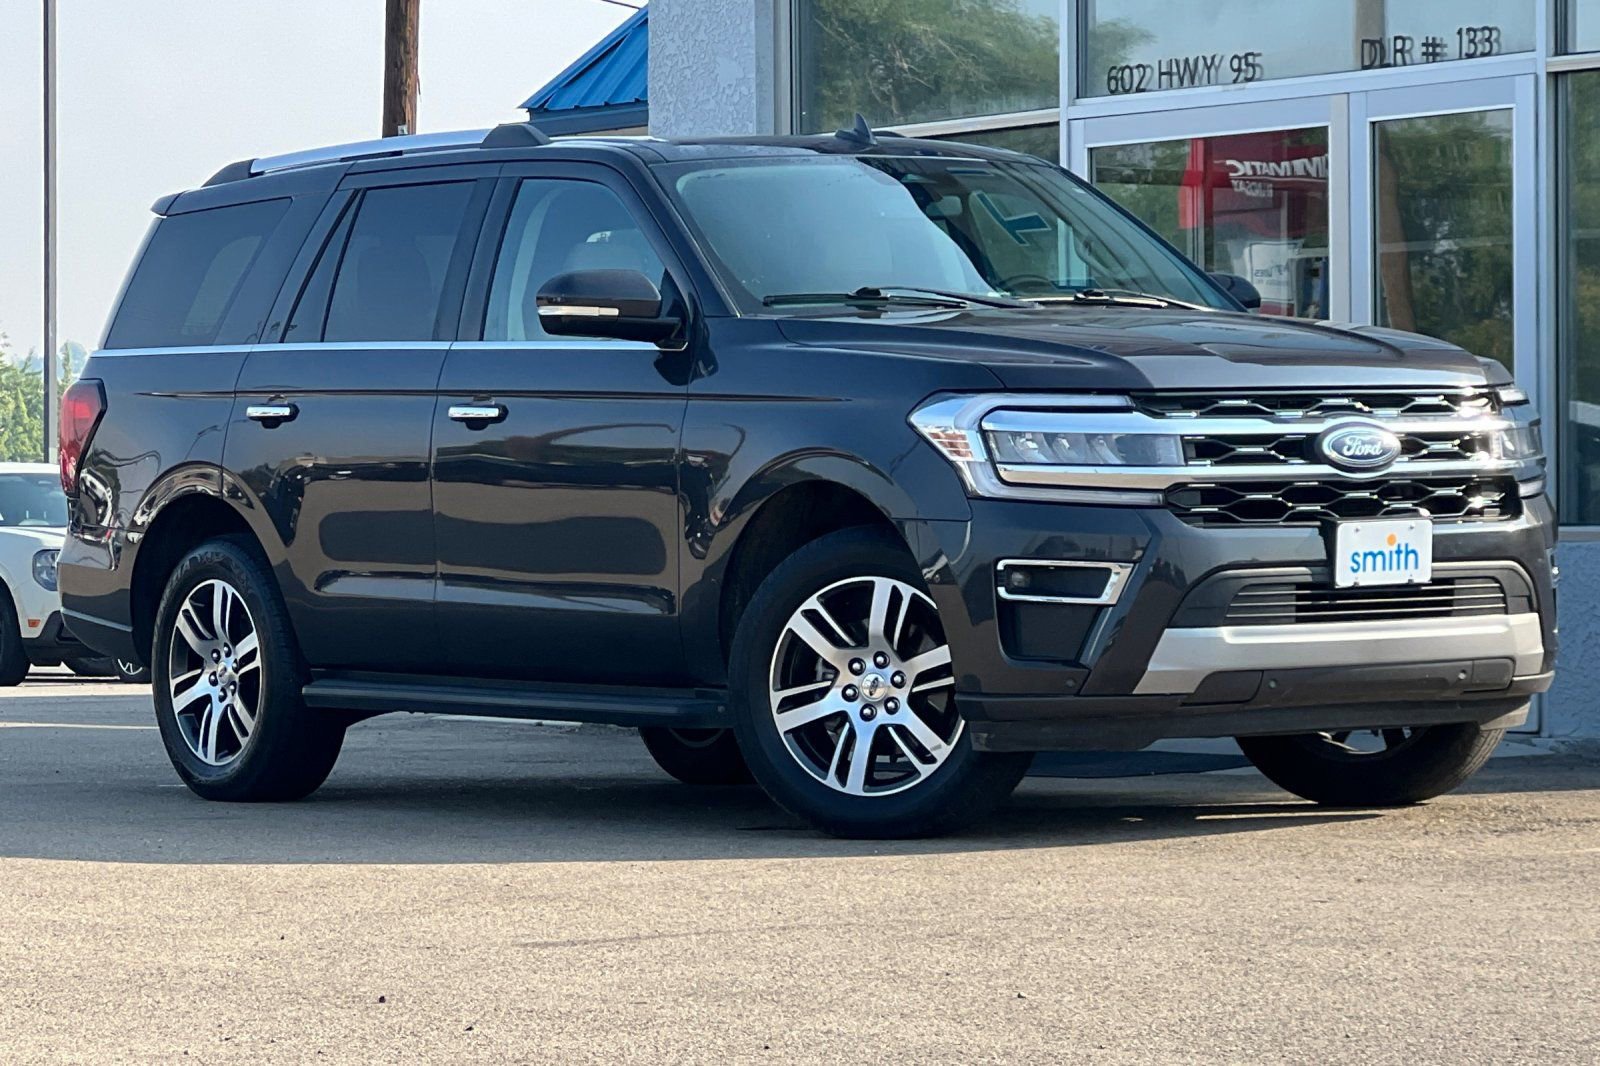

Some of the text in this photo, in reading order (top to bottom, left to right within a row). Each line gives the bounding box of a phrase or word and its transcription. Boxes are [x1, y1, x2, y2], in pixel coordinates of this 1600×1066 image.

[1361, 35, 1407, 70] DLR
[1456, 25, 1495, 60] 133
[1107, 52, 1258, 95] 602 HWY 95
[1343, 435, 1383, 457] Ford
[1350, 533, 1419, 573] smith
